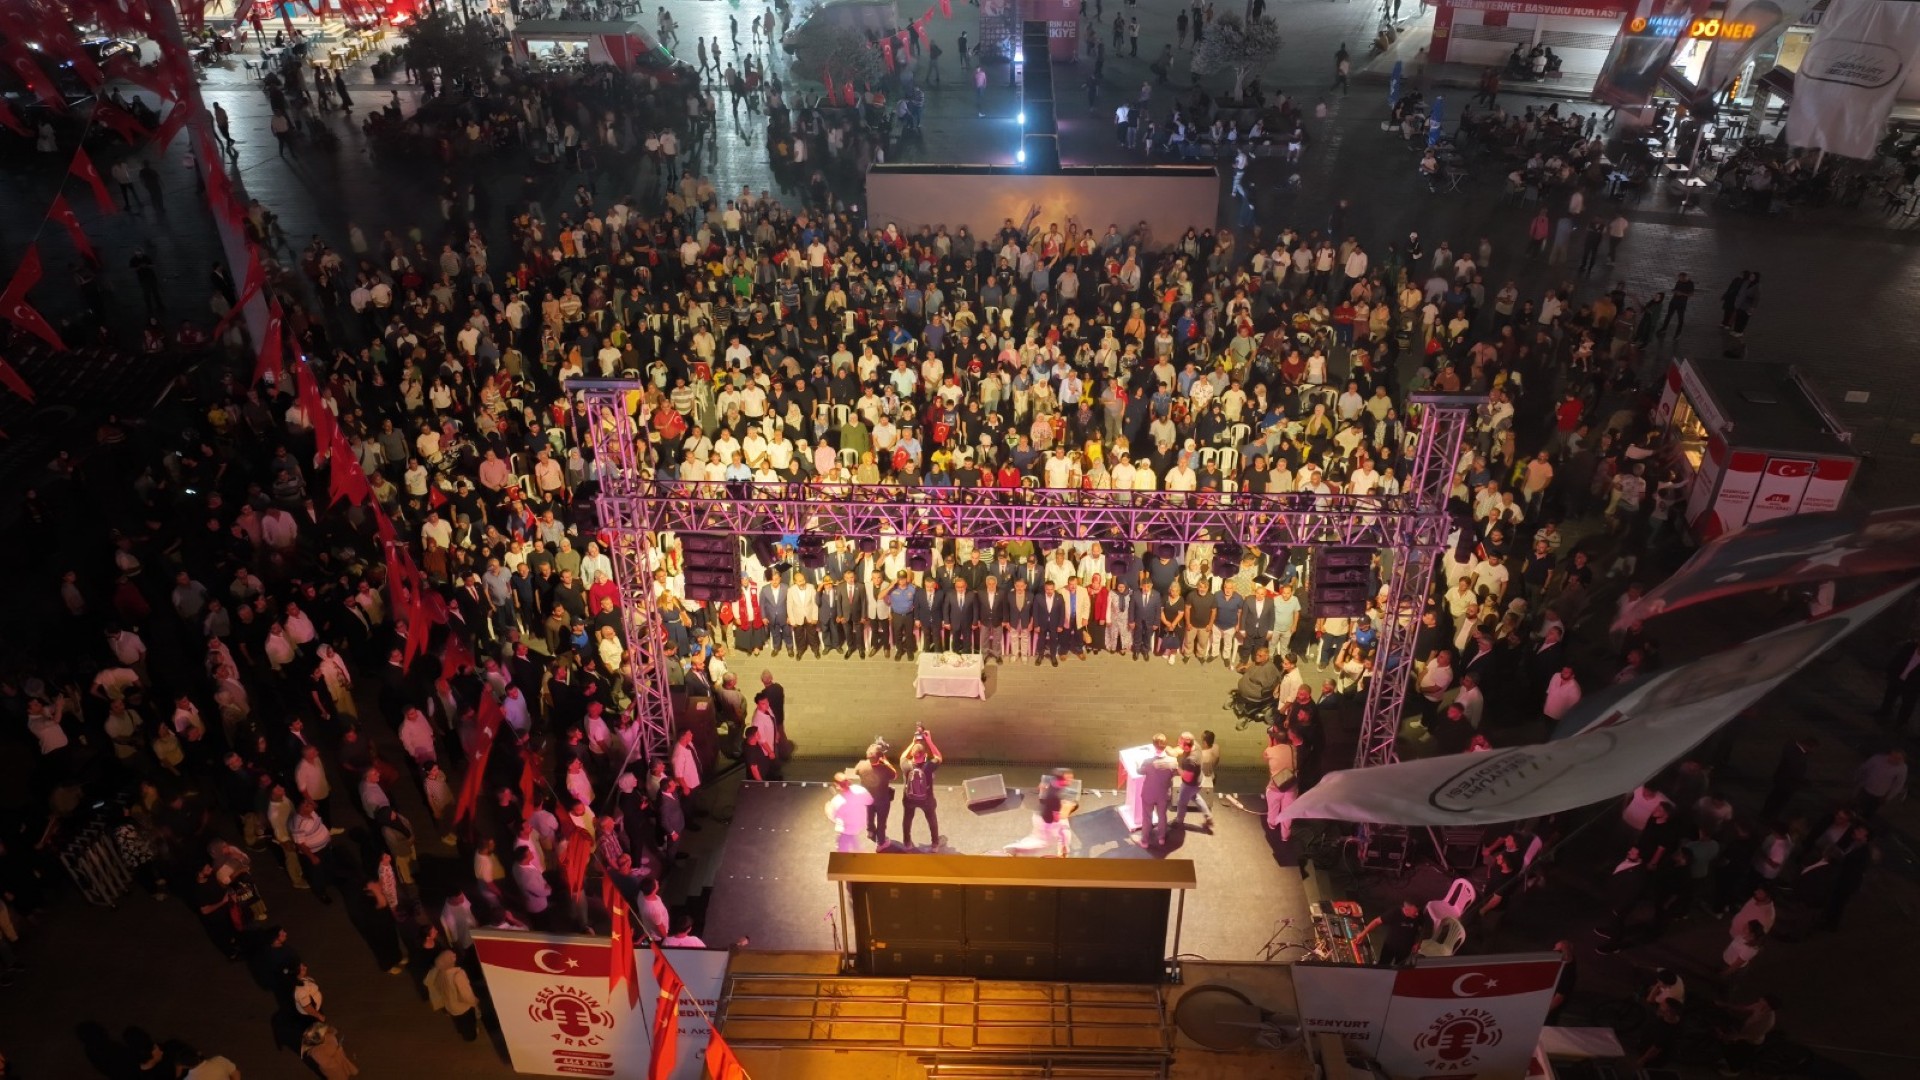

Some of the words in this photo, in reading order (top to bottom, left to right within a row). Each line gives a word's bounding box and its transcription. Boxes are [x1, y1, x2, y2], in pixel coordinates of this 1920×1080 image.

[1691, 17, 1756, 39] DÖNER
[535, 986, 554, 1004] SES
[556, 984, 600, 1009] YAYIN
[1429, 1012, 1455, 1031] SES
[1460, 1008, 1497, 1028] YAYIN
[551, 1033, 606, 1047] ARACI
[1424, 1055, 1480, 1071] ARACI
